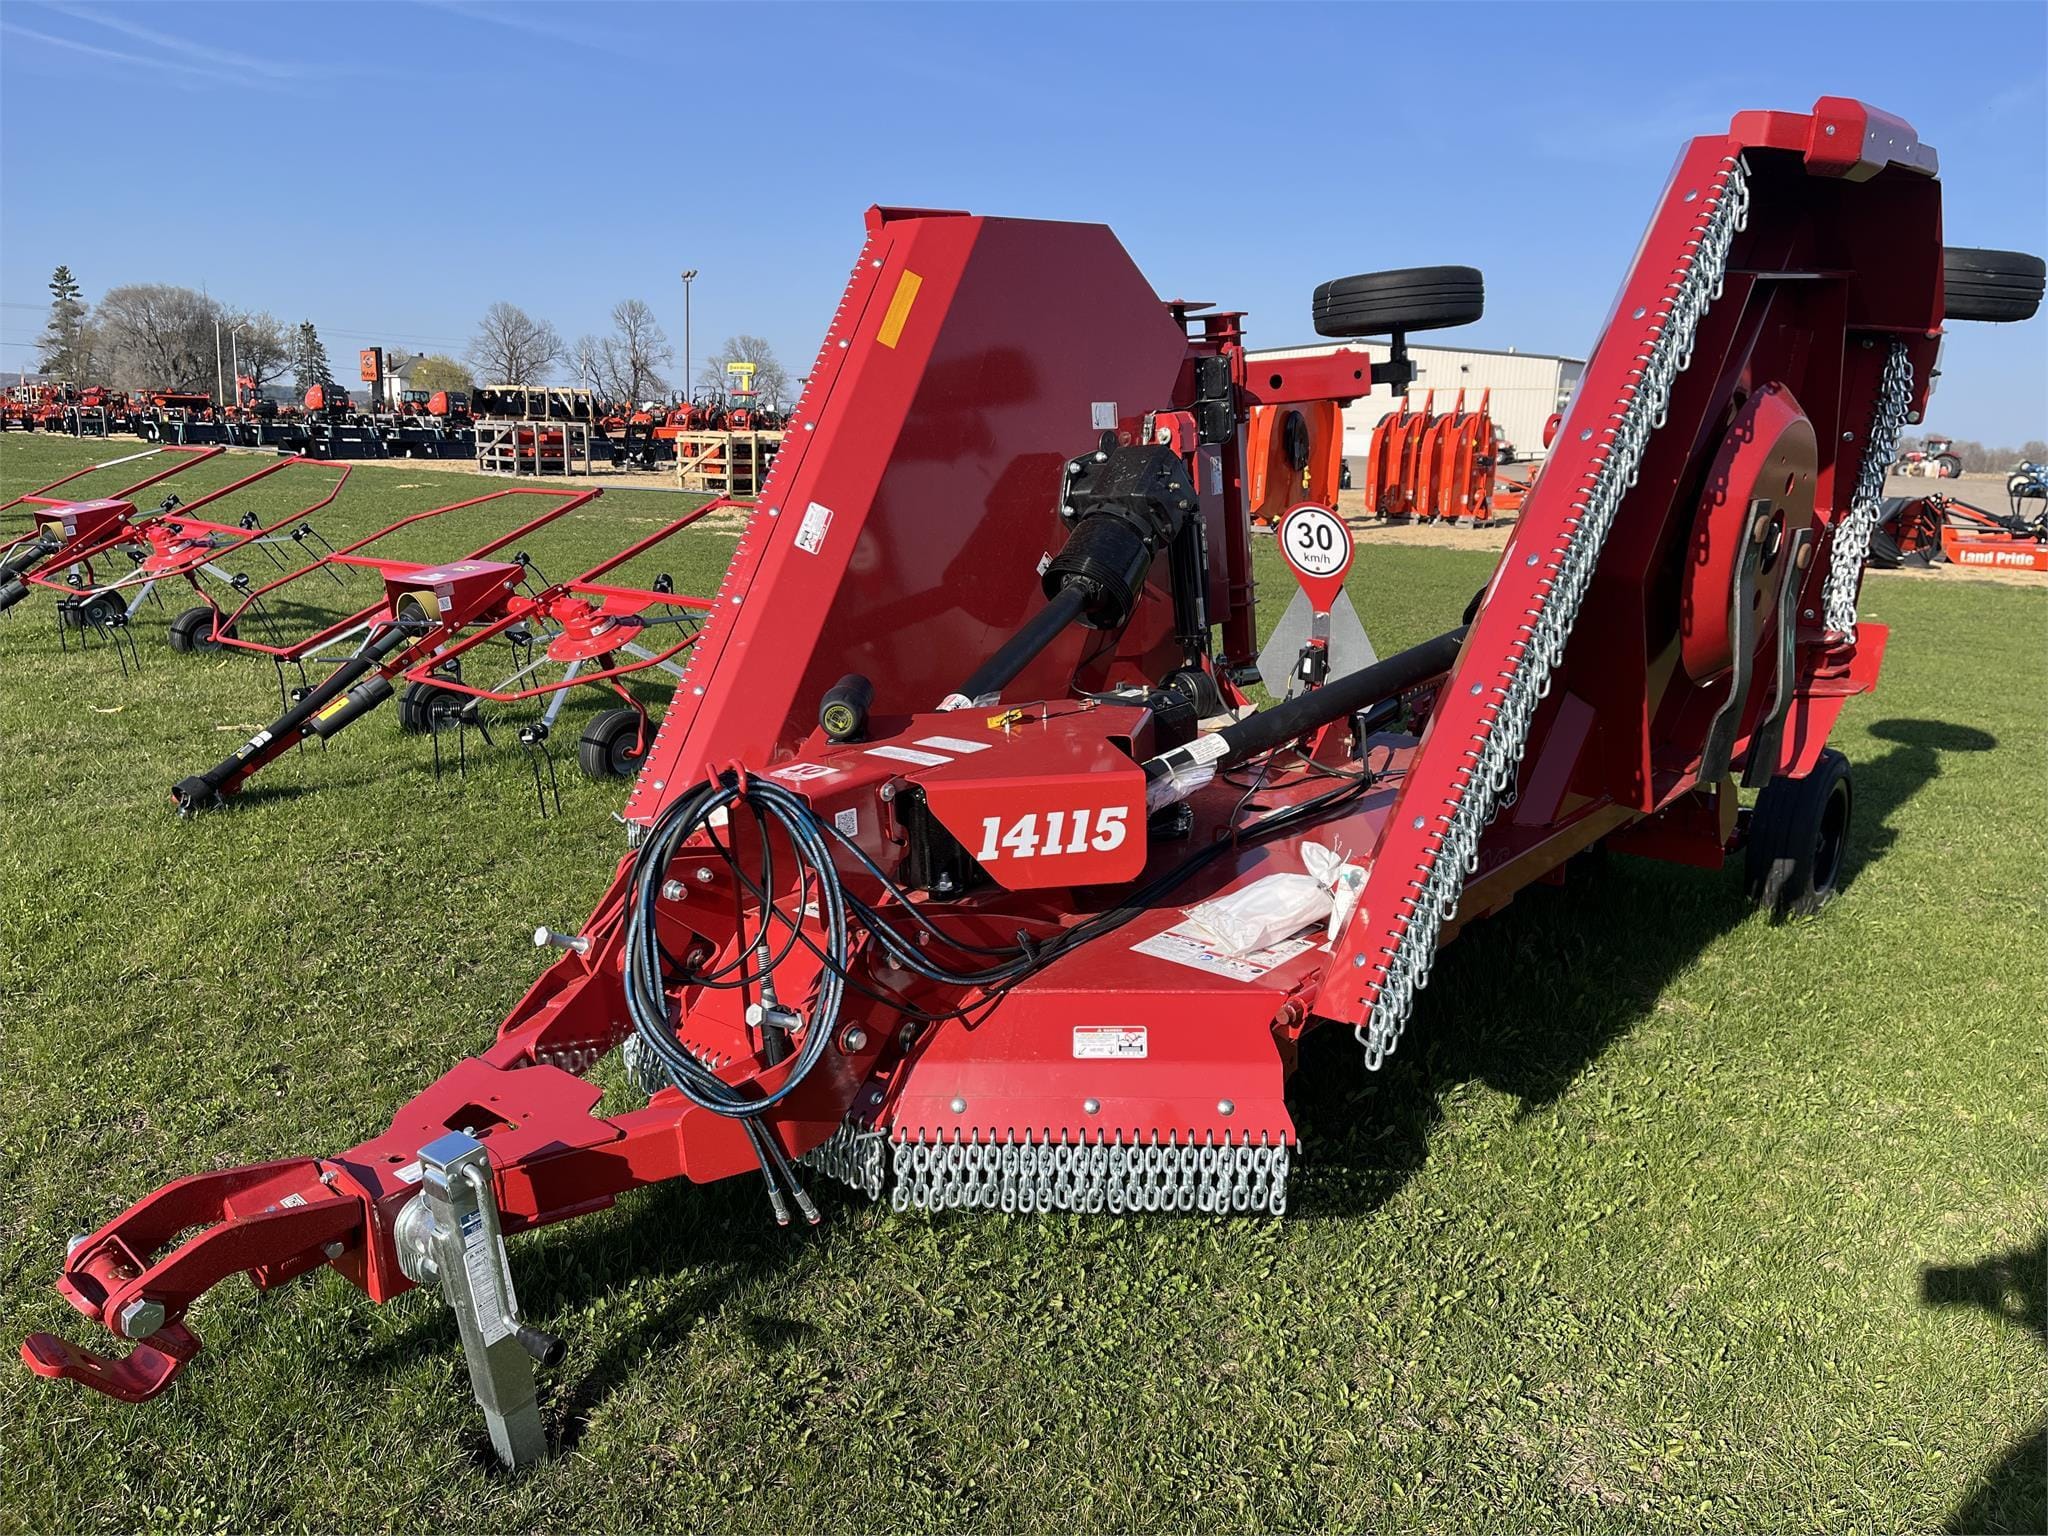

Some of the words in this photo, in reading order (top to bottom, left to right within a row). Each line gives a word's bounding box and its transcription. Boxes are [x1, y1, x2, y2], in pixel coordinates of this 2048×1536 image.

[1297, 522, 1333, 551] 30
[1303, 552, 1331, 564] km/h
[1960, 550, 1994, 563] Land
[1996, 551, 2035, 566] Pride
[976, 806, 1129, 862] 14115
